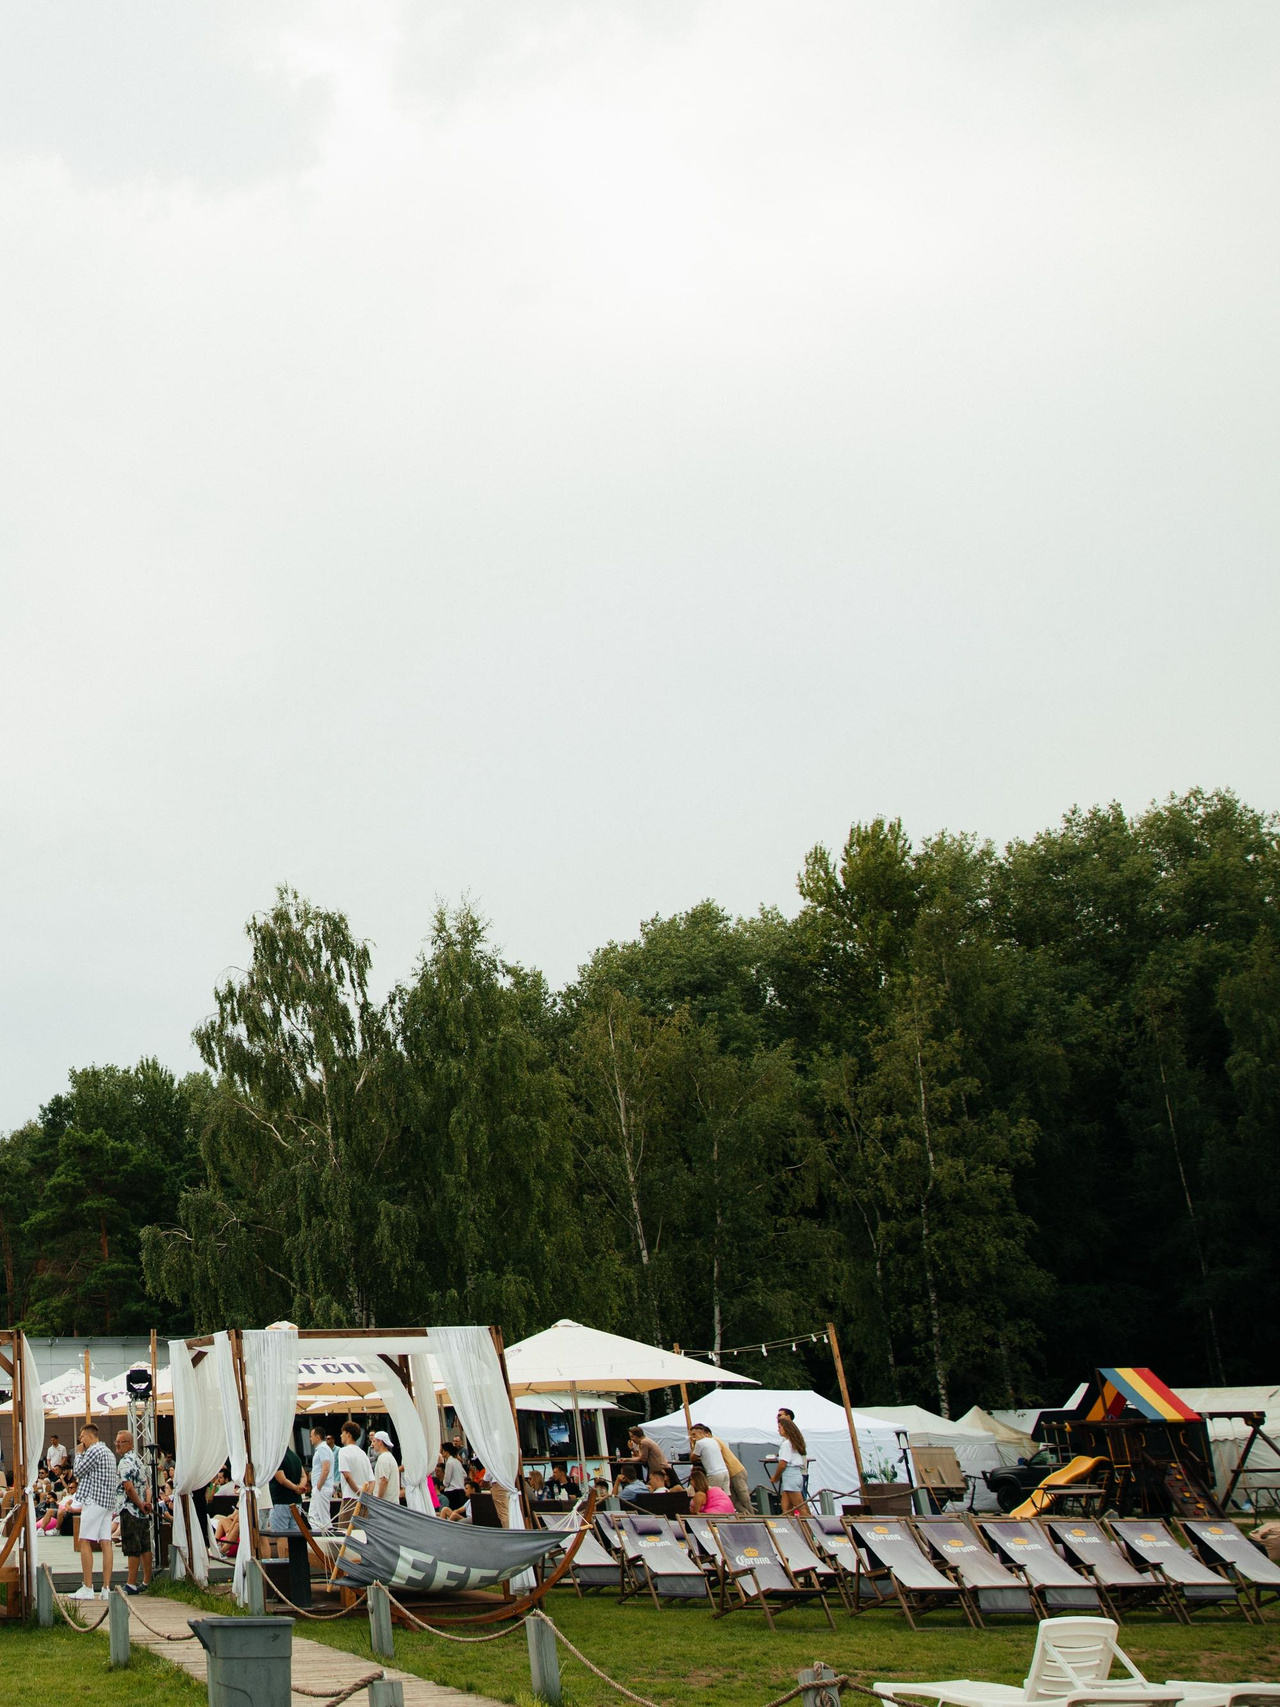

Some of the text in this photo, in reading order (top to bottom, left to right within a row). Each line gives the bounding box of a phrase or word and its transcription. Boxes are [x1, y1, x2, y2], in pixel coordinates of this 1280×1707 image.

[866, 1531, 902, 1541] Corona
[1065, 1533, 1102, 1544] Corona
[1201, 1531, 1238, 1541] Corona
[638, 1540, 671, 1549] Corona
[1006, 1541, 1041, 1551] Corona
[1134, 1538, 1170, 1549] Corona
[942, 1544, 979, 1554] Corona
[736, 1556, 773, 1567] Corona
